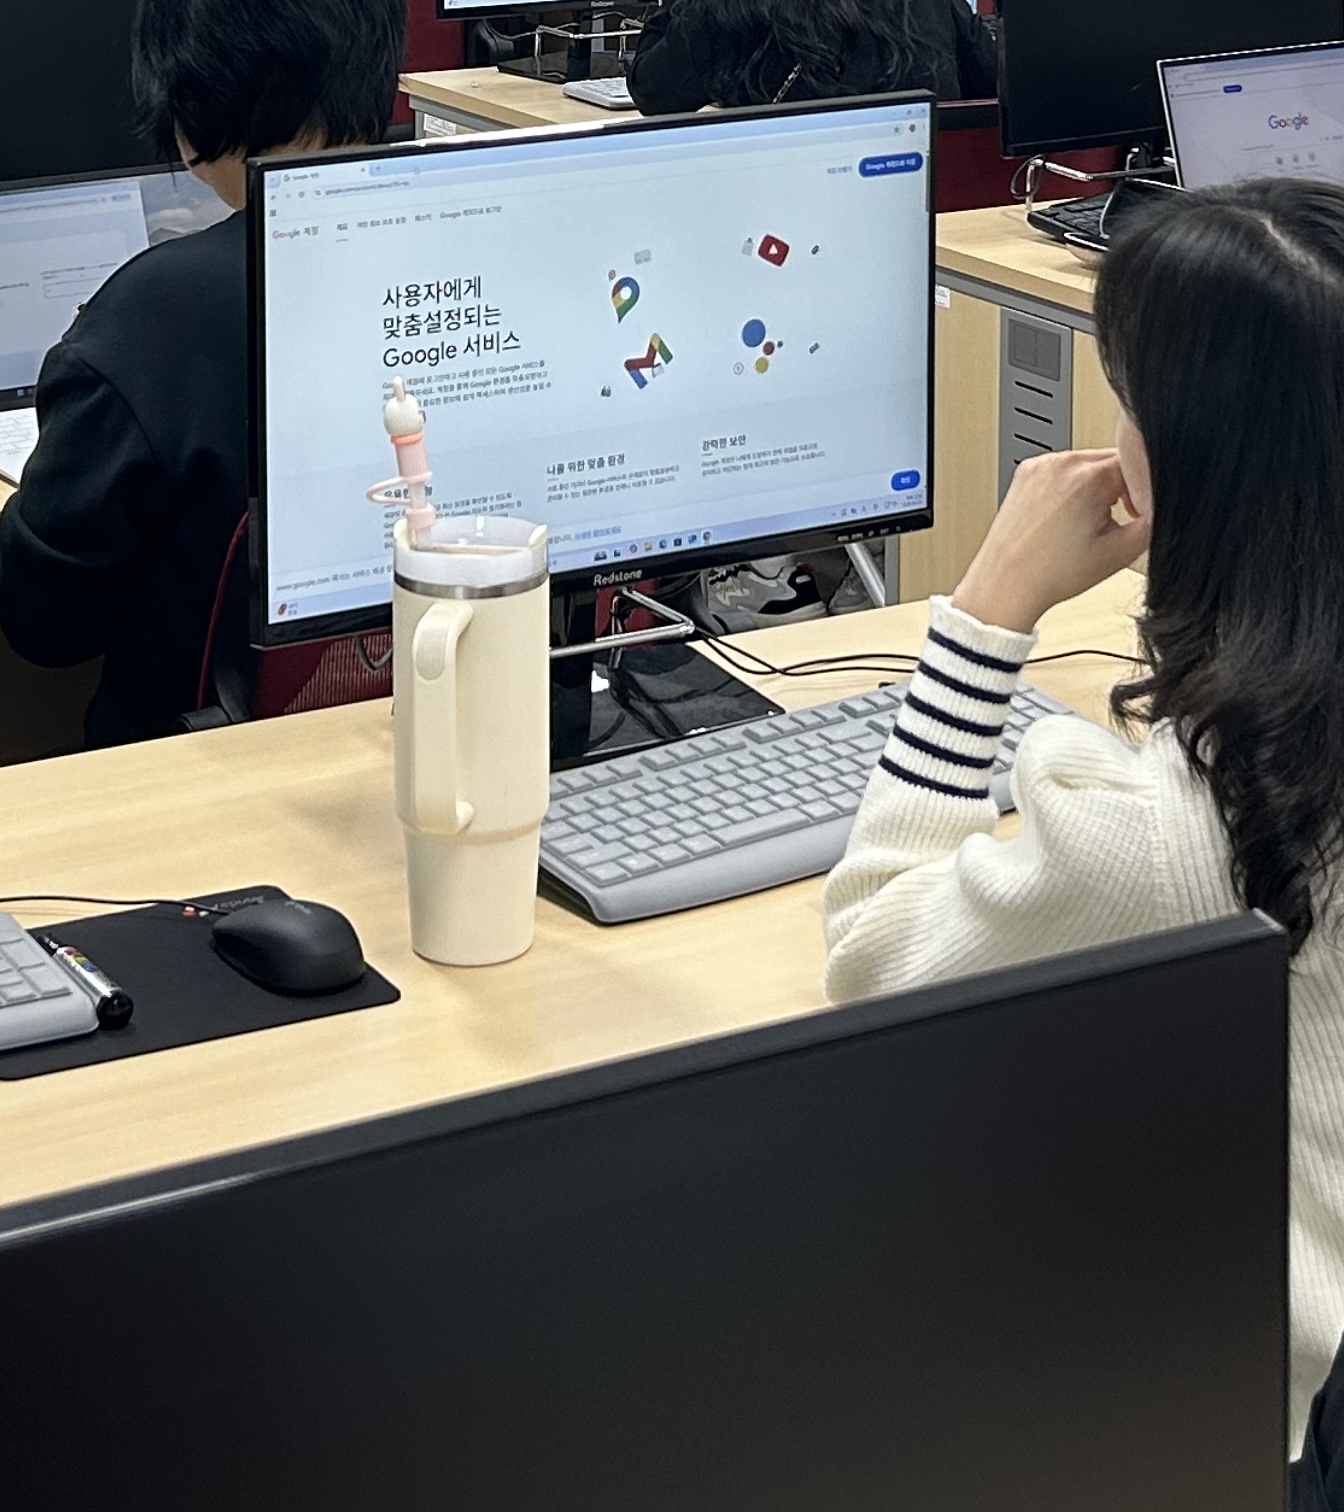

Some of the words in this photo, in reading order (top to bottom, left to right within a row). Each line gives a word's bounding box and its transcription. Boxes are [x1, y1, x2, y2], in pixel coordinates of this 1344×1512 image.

[1268, 112, 1309, 130] Google
[382, 275, 482, 309] 사용자에게
[383, 304, 503, 340] 맞춤설정되는
[383, 340, 458, 368] Google
[463, 329, 522, 358] 서비스
[593, 568, 643, 586] Redstone
